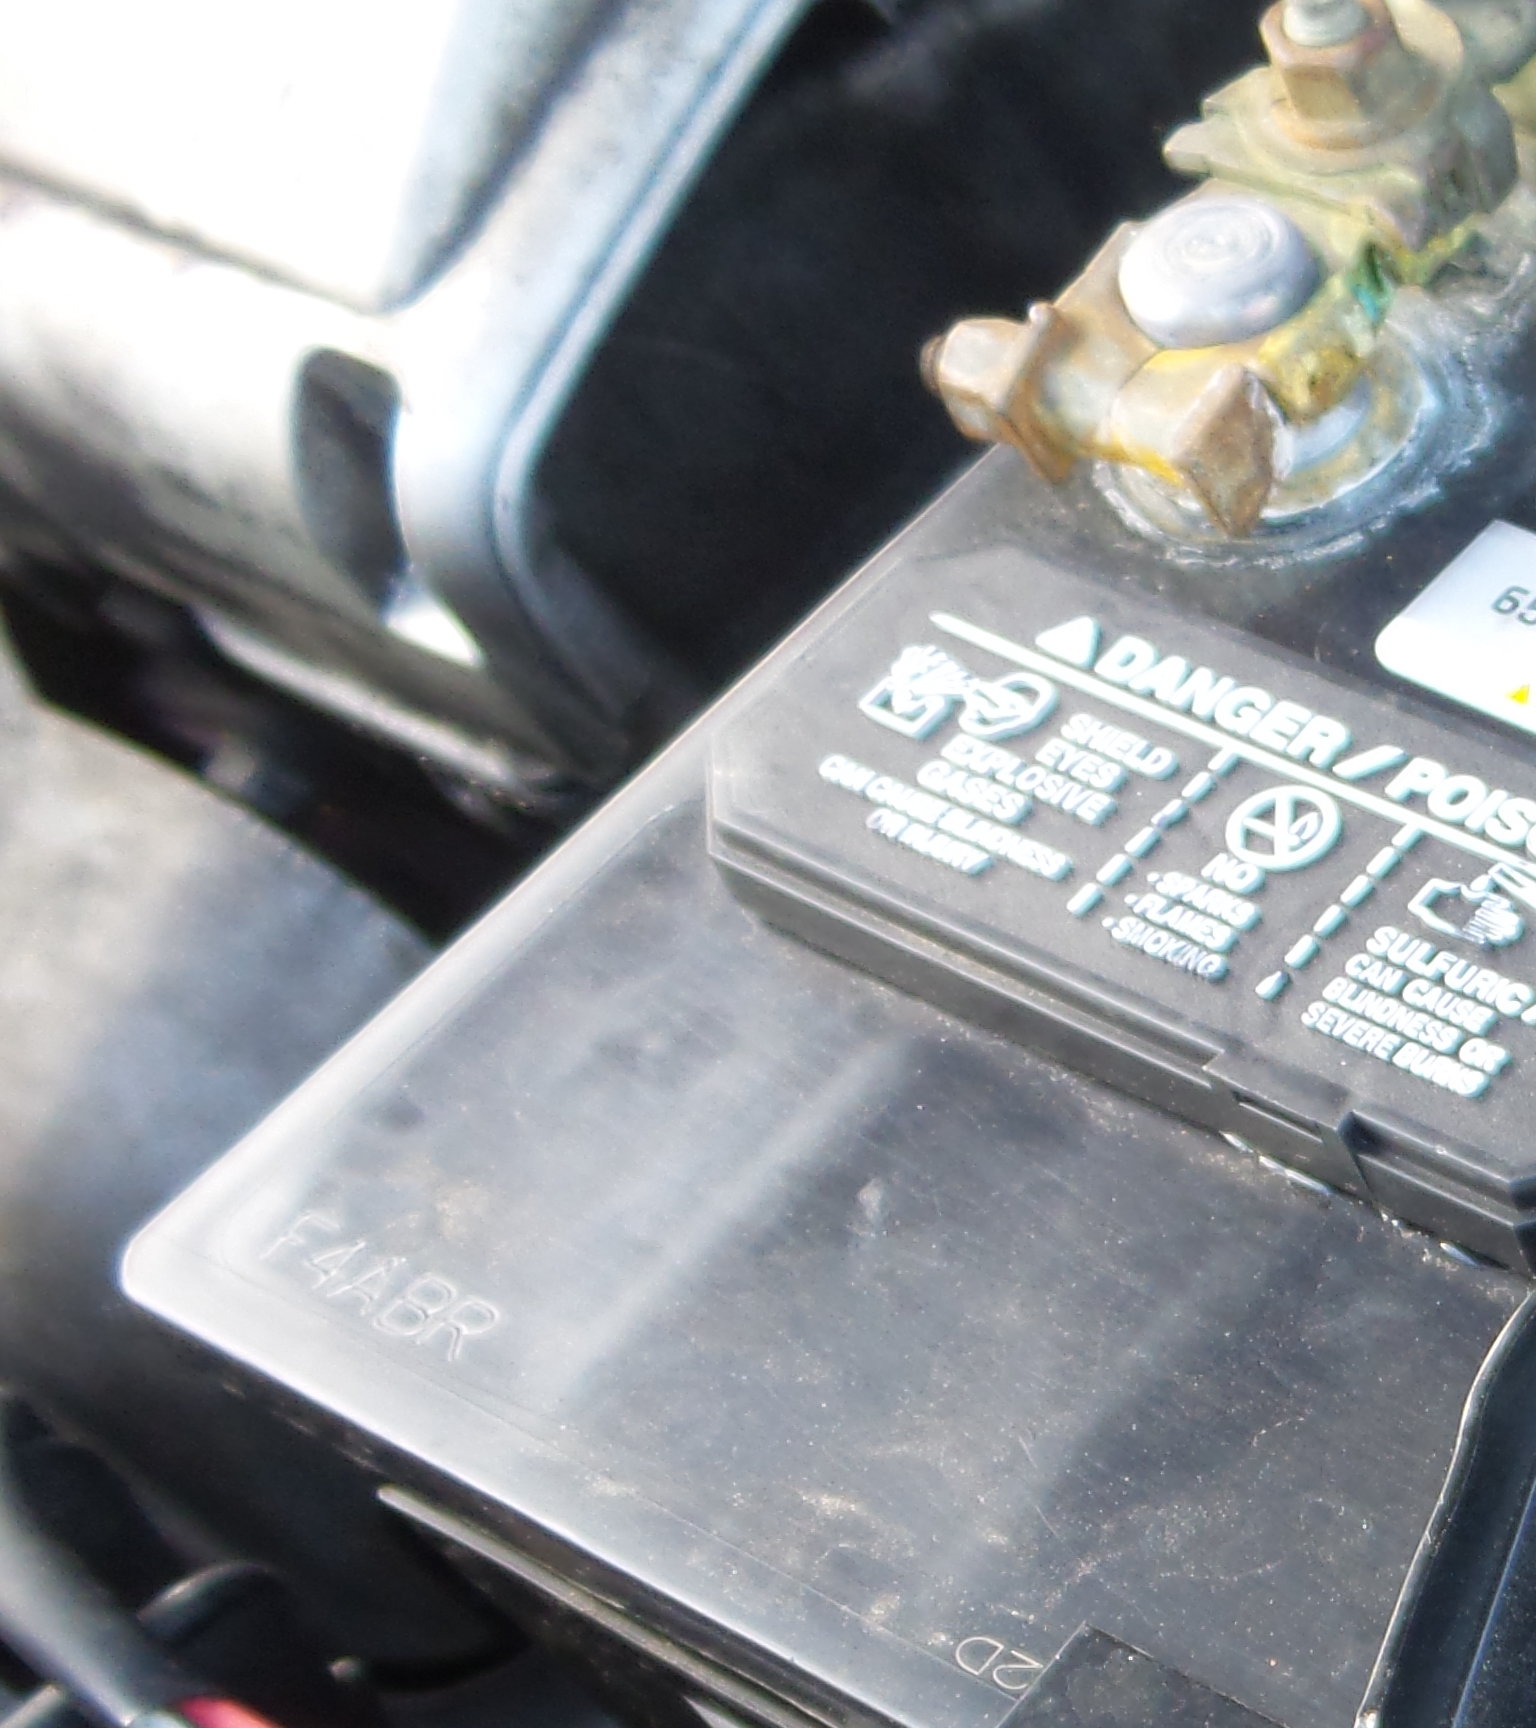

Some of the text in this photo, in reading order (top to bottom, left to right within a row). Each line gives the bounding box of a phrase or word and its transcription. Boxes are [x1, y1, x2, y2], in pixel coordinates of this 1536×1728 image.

[1095, 636, 1347, 764] DANGER
[940, 733, 1111, 821] EXPLOSIVE
[1035, 737, 1121, 788] EYES
[1061, 713, 1172, 774] SHIELD
[917, 759, 1027, 821] GASES
[1201, 853, 1265, 892] NO
[1345, 954, 1494, 1033] CAN CAUSE
[1366, 926, 1532, 1014] SULFURIC
[1301, 1001, 1485, 1095] SEVERE BURNS
[1322, 977, 1506, 1073] BLINDNESS OR
